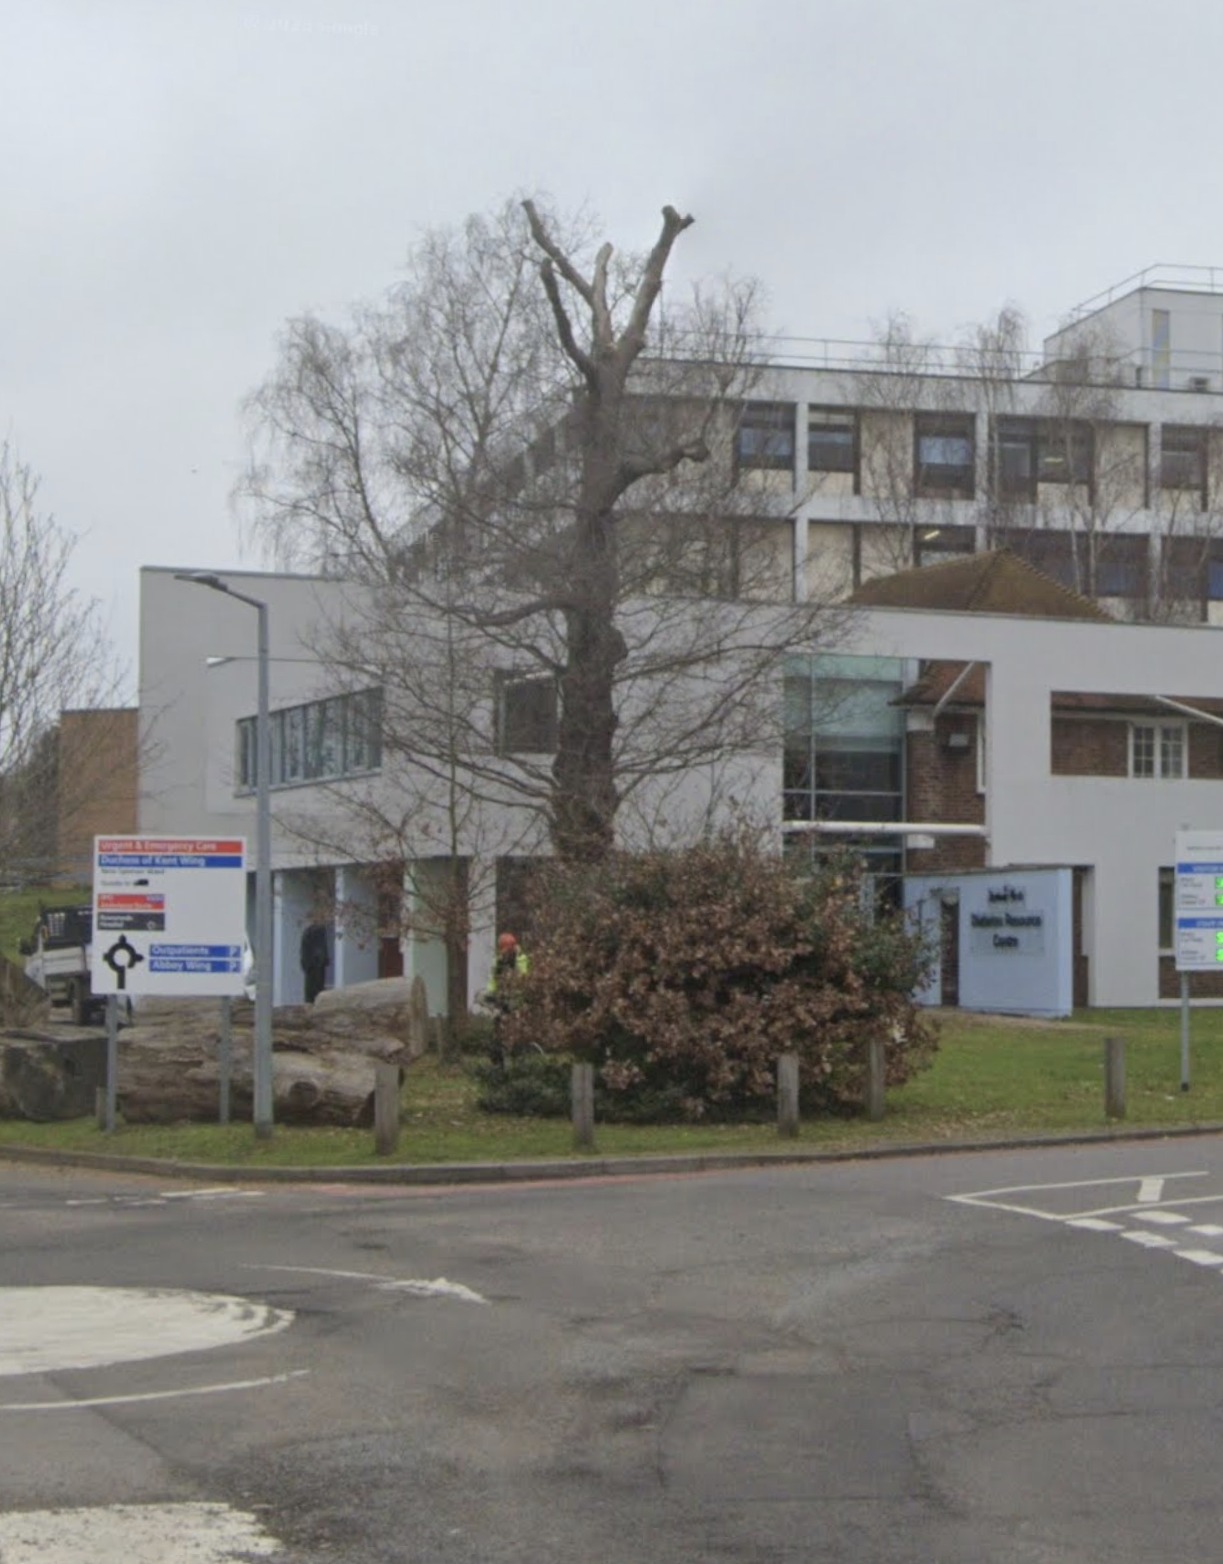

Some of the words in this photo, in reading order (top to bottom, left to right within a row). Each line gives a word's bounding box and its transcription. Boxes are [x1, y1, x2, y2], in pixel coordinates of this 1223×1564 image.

[101, 841, 133, 852] Urgent
[145, 842, 194, 852] Emergency
[196, 842, 216, 851] Care
[101, 855, 140, 865] Duchess
[155, 857, 177, 866] Kent
[179, 857, 206, 867] Wing
[152, 946, 209, 957] Outpatients
[152, 960, 183, 971] Abbey
[187, 961, 212, 972] Wing
